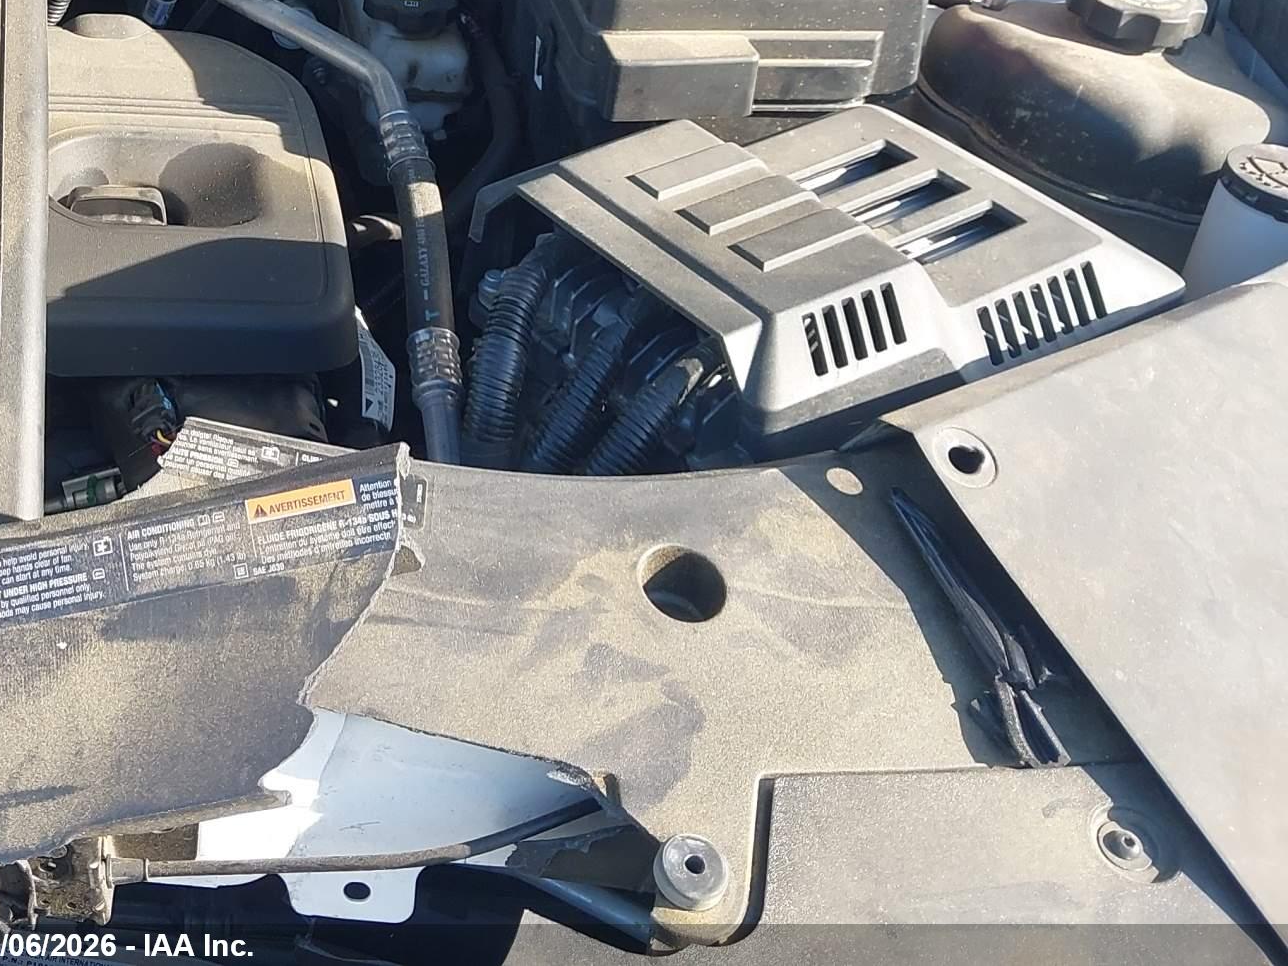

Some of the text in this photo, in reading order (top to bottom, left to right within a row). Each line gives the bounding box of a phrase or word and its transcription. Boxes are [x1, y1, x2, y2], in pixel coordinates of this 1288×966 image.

[359, 480, 391, 493] Attention
[269, 491, 345, 515] AVERTISSEMENT
[127, 519, 194, 540] AIR CONDITIONING
[257, 530, 284, 545] FLUIDE
[369, 511, 390, 522] SOUS
[299, 538, 308, 546] du
[3, 556, 18, 568] help
[19, 552, 37, 565] avoid
[39, 545, 67, 563] personal
[13, 563, 33, 574] hands
[34, 558, 51, 570] clear
[53, 557, 60, 566] of
[188, 561, 204, 570] 0.65
[206, 558, 215, 568] kg
[261, 552, 275, 565] Des
[2, 575, 14, 585] can
[15, 571, 32, 583] start
[33, 570, 40, 580] at
[41, 568, 54, 579] any
[253, 566, 267, 576] SAE
[3, 586, 28, 598] UNDER
[30, 582, 48, 593] HIGH
[49, 573, 87, 589] PRESSURE
[1, 598, 10, 609] by
[10, 592, 40, 607] qualified
[41, 586, 74, 602] personnel
[15, 606, 30, 618] may
[31, 602, 51, 613] cause
[53, 595, 82, 610] personal
[83, 590, 105, 604] injury.
